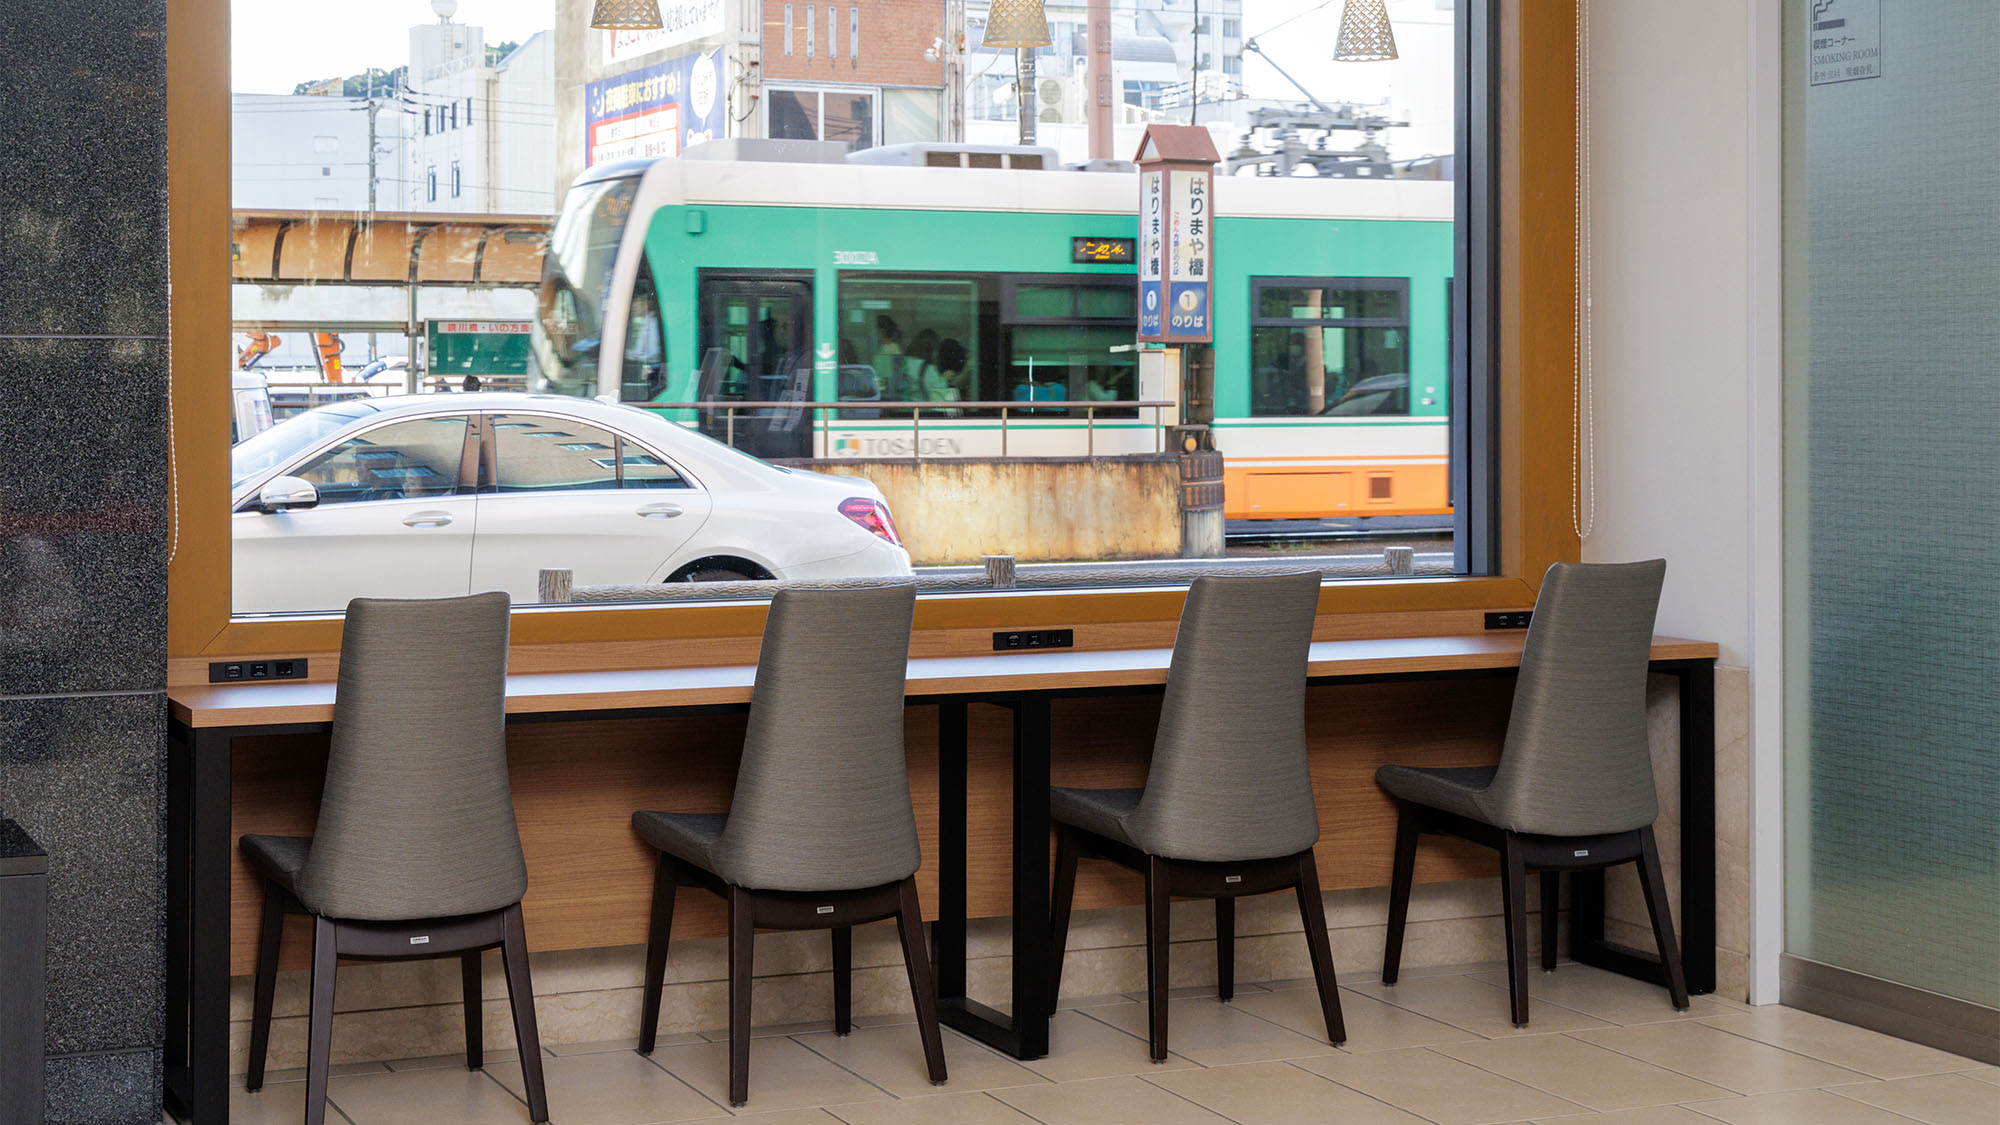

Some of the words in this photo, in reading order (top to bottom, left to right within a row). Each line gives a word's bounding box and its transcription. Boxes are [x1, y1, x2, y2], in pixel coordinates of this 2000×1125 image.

[1813, 51, 1852, 66] SMOKING
[1853, 47, 1878, 61] ROOM
[1150, 176, 1160, 276] はりまや橋
[1188, 177, 1204, 276] はりまや橋
[1172, 314, 1204, 328] のりば
